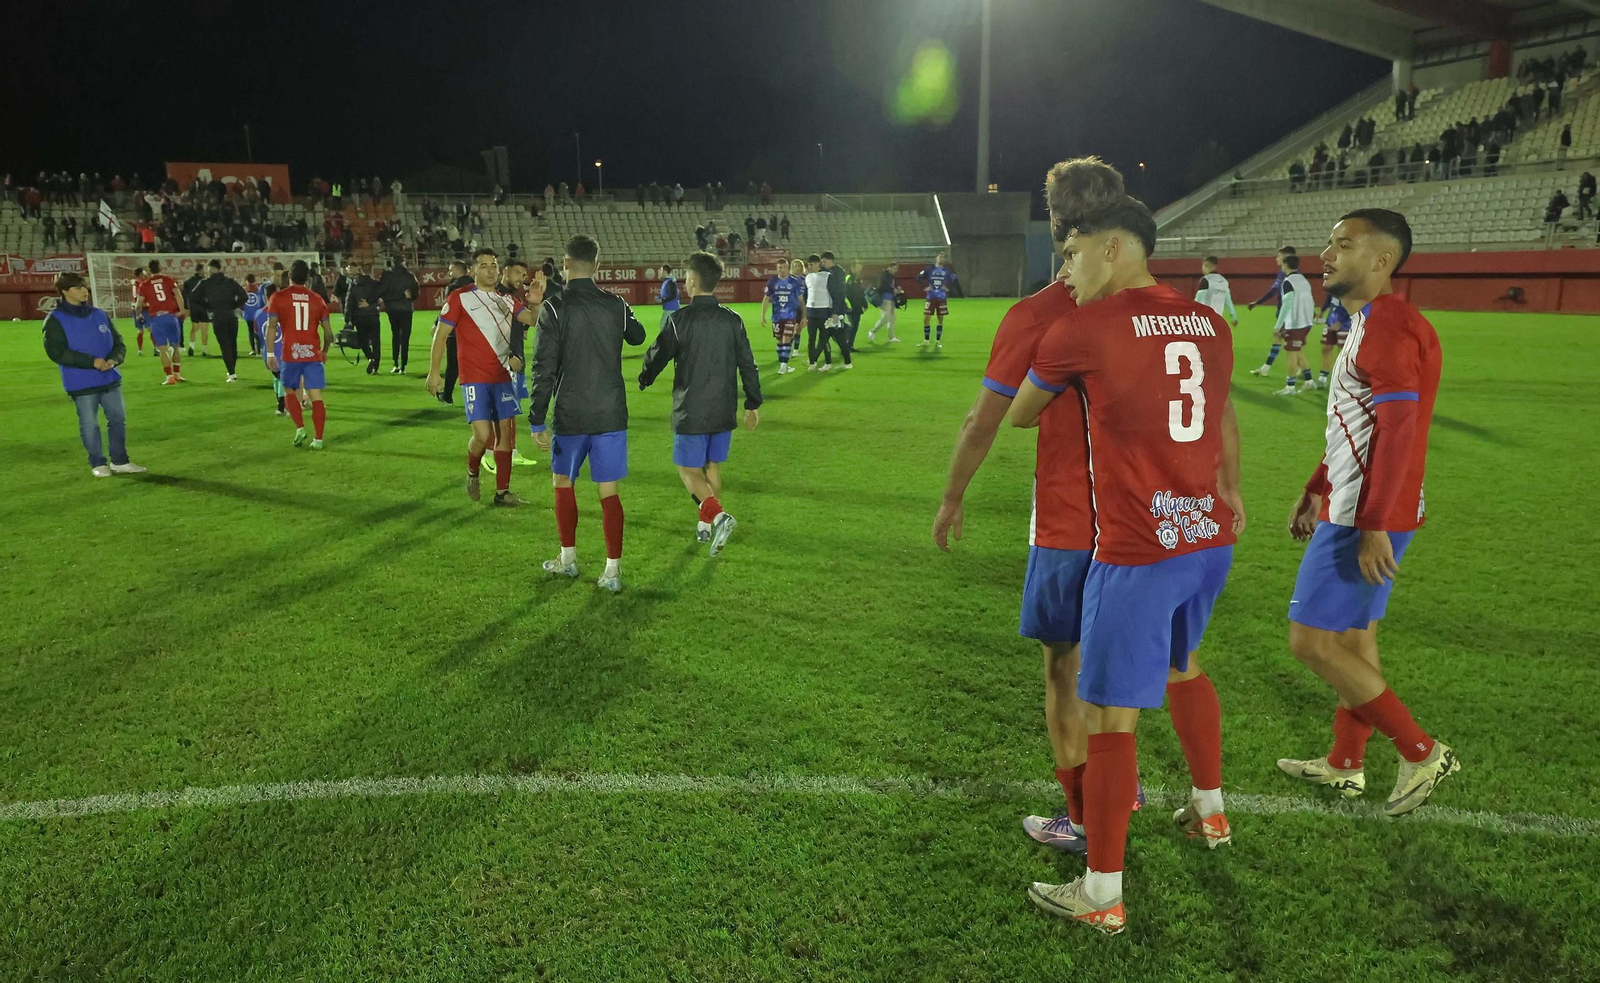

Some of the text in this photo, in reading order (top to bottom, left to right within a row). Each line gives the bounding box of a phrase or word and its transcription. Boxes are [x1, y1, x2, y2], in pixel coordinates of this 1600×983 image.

[615, 269, 637, 280] SUR
[153, 283, 167, 302] 5
[292, 301, 310, 331] 11
[1131, 311, 1217, 338] MERCHÁN
[464, 385, 476, 403] 19
[1164, 341, 1206, 443] 3
[1149, 490, 1216, 526] Algeciras
[1180, 515, 1221, 544] Gusta
